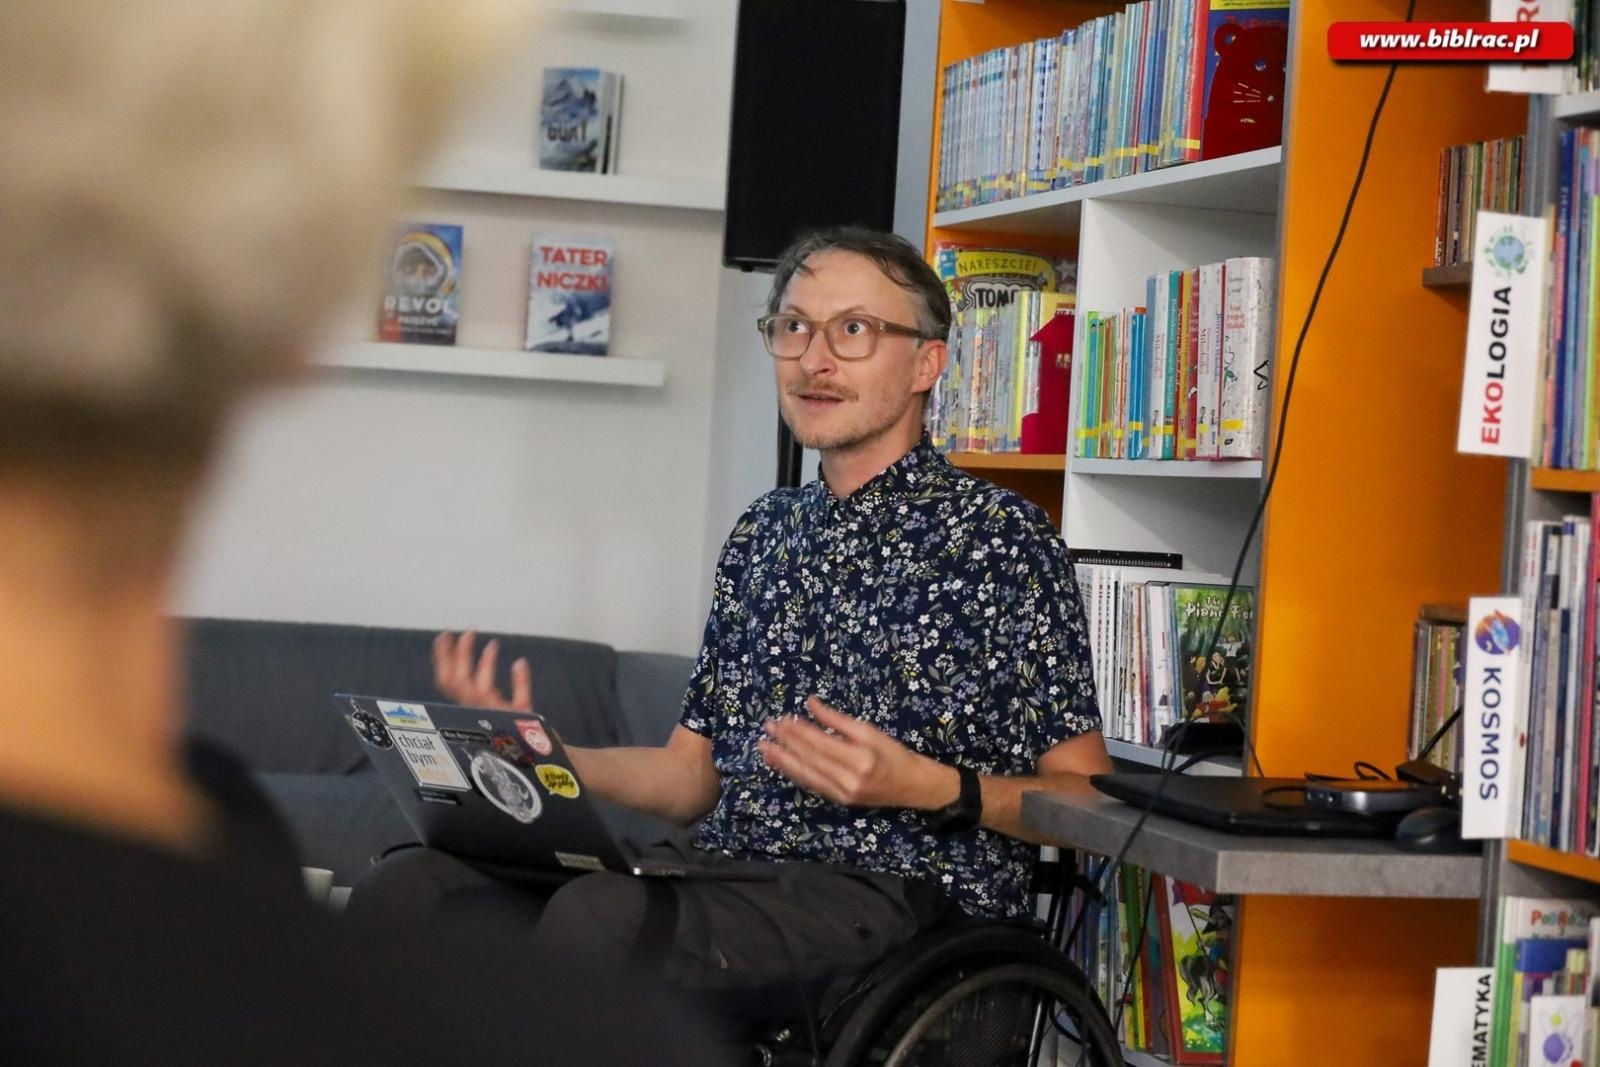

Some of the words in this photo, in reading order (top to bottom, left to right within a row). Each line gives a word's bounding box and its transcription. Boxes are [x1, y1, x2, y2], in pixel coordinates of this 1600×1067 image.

[539, 245, 609, 267] TATER
[959, 257, 1037, 274] NARESZCIE!
[536, 271, 609, 292] NICZKI
[1480, 286, 1512, 445] EKOLOGIA
[1478, 666, 1503, 801] KOSMOS
